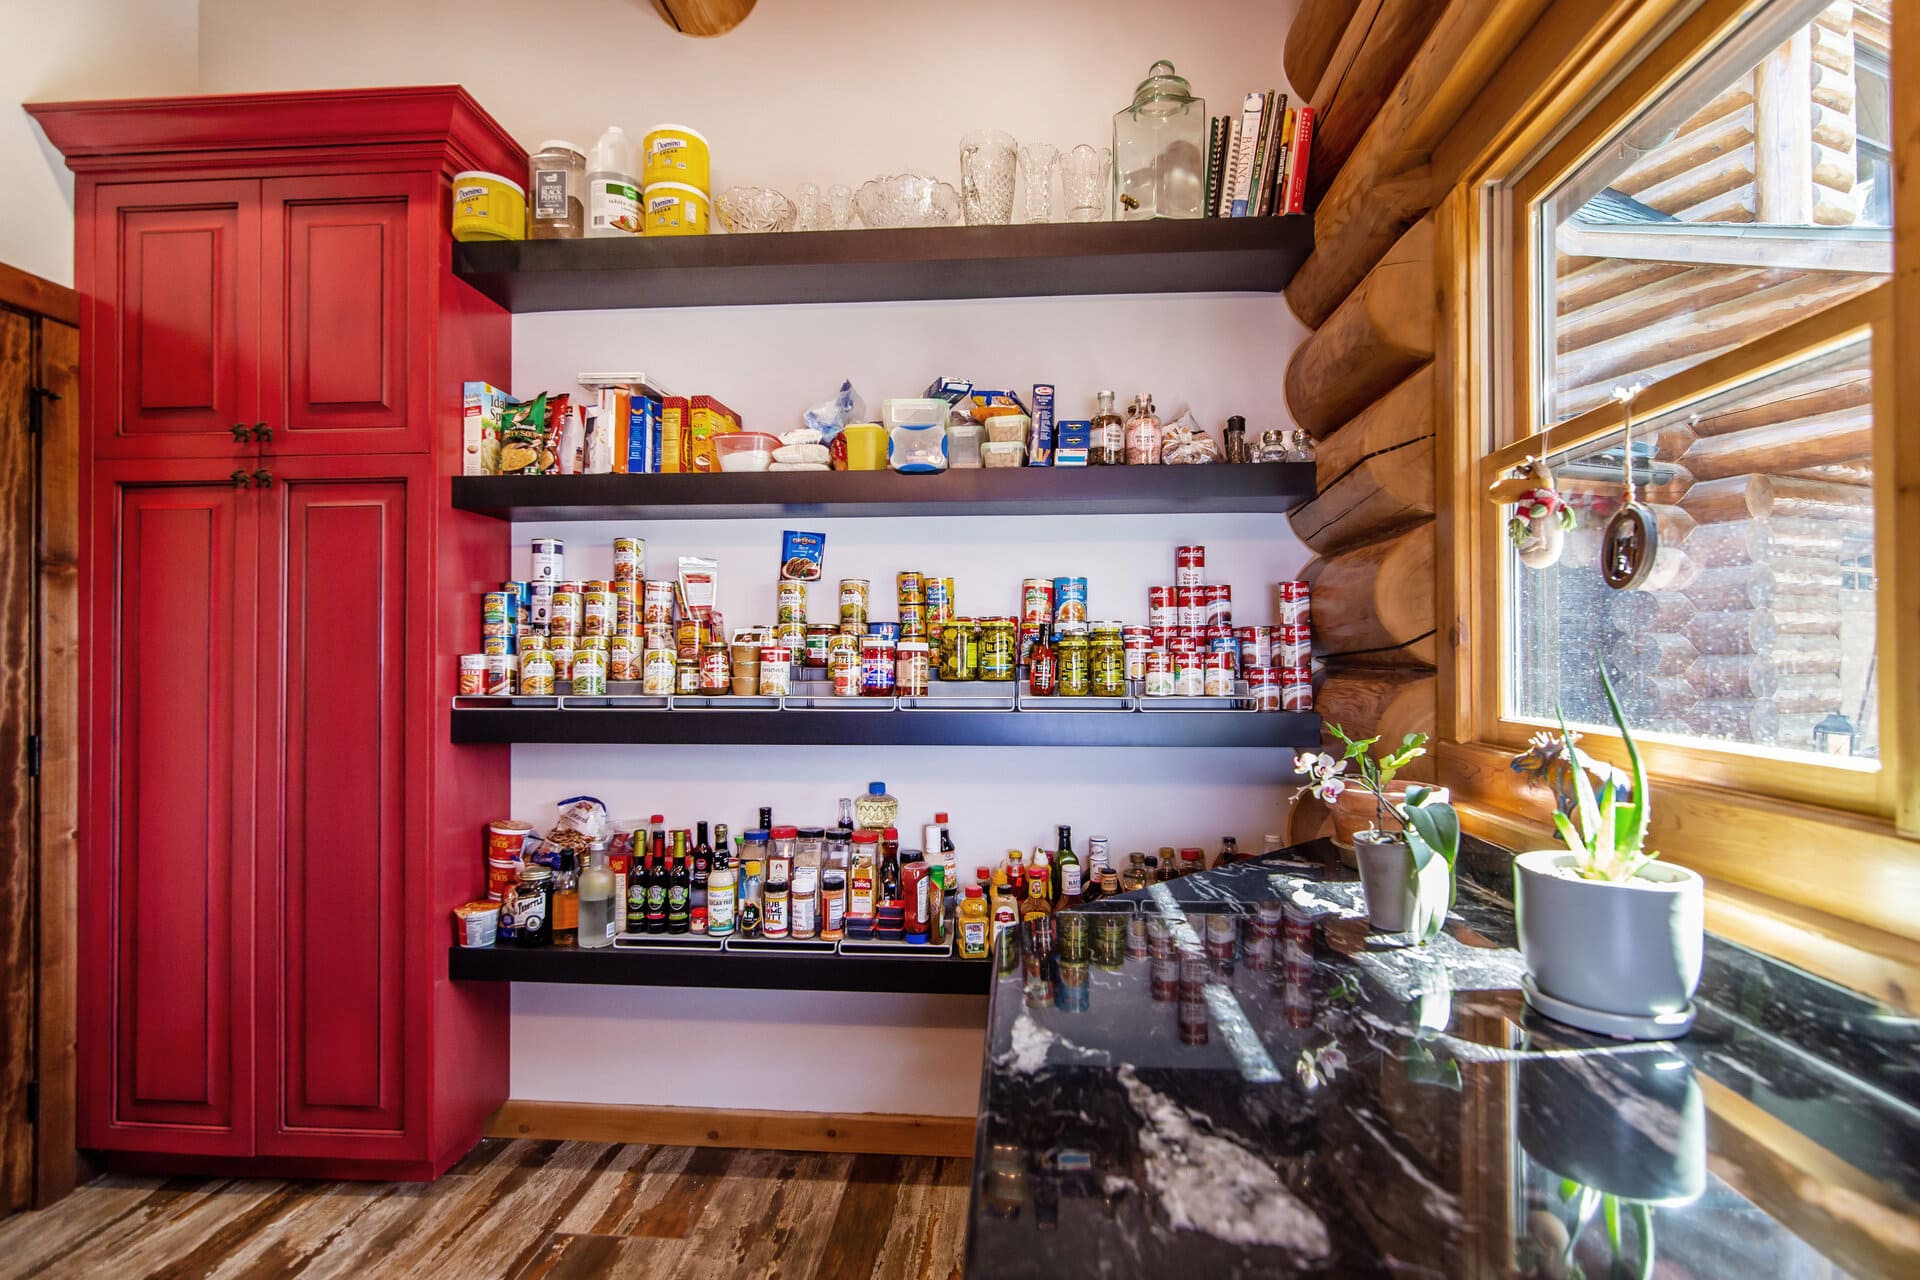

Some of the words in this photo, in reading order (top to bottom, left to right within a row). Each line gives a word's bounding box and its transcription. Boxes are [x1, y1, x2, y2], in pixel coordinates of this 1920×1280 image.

[657, 140, 681, 150] Domino
[1236, 136, 1252, 183] BAKING
[460, 187, 482, 200] Domino
[651, 198, 674, 210] Domino
[490, 408, 501, 424] Sp
